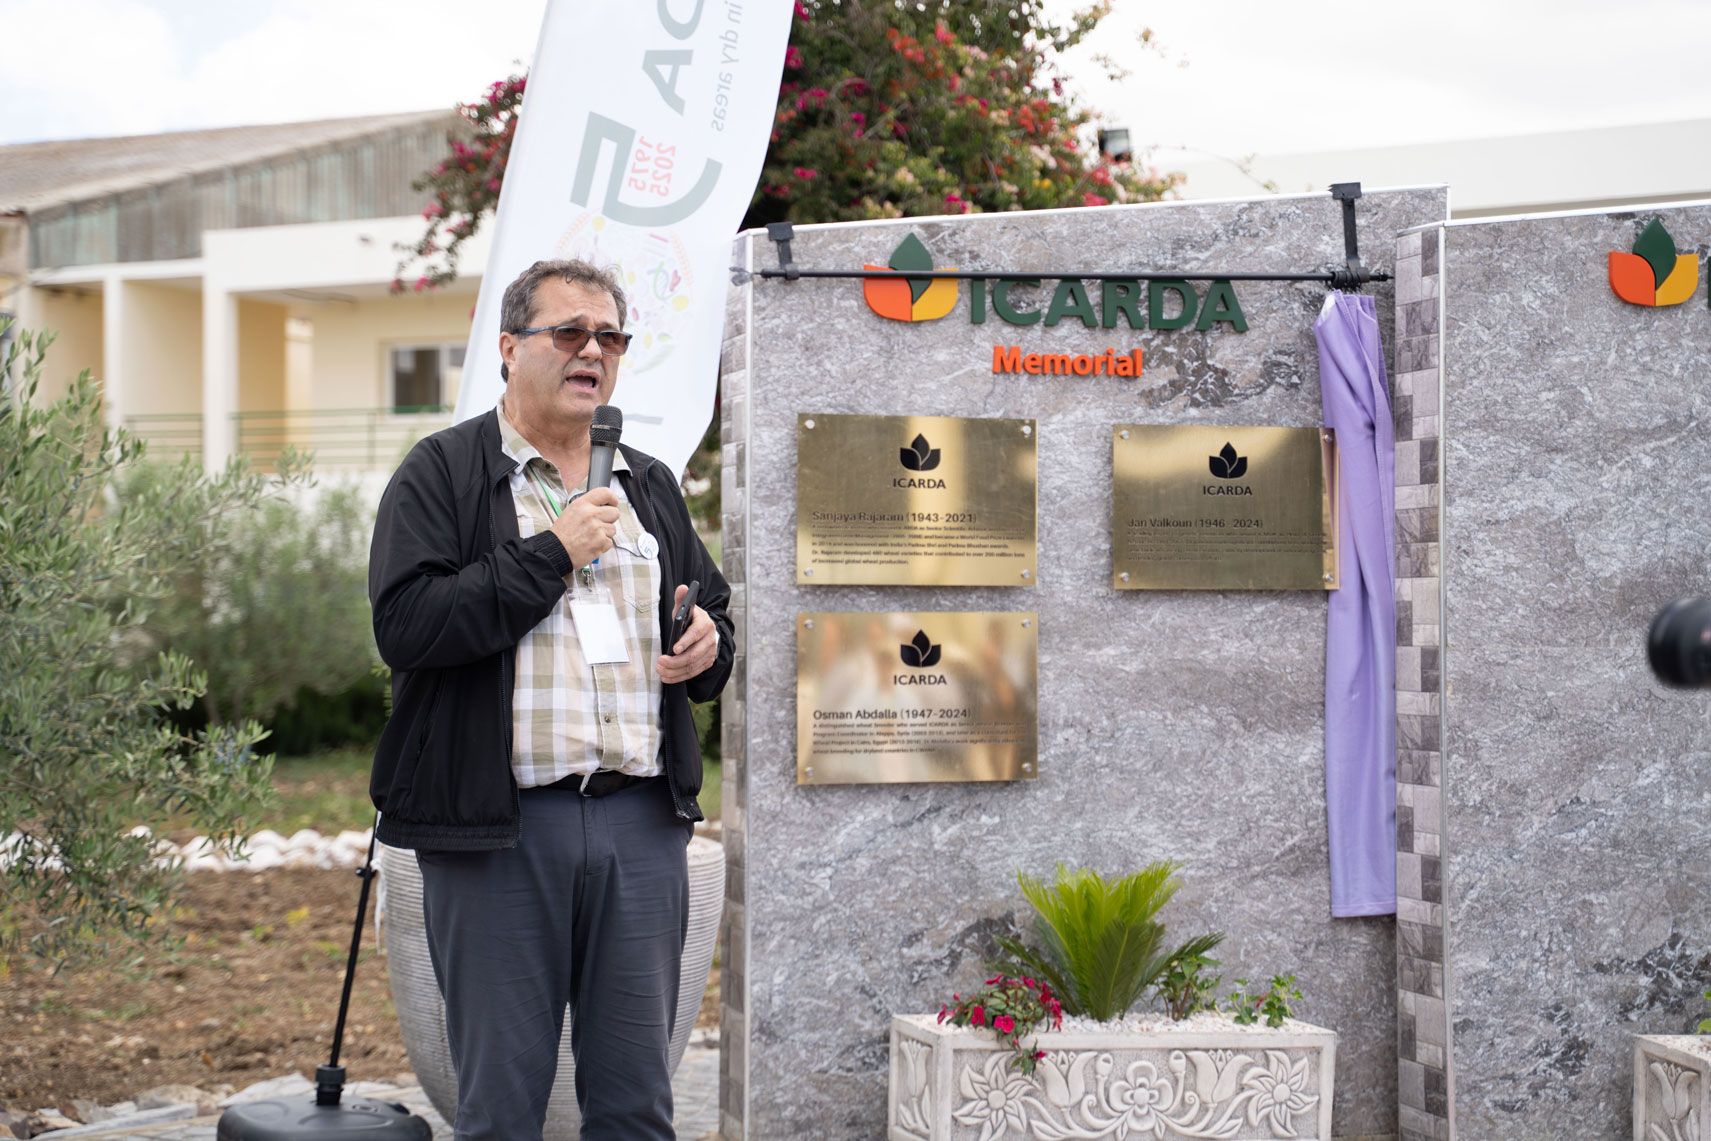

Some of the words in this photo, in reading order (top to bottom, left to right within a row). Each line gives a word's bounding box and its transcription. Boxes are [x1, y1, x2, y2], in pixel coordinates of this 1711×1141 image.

[970, 274, 1249, 332] ICARDA
[992, 345, 1143, 378] Memorial
[892, 478, 946, 489] ICARDA
[1203, 485, 1253, 496] ICARDA
[812, 511, 856, 522] Sanjaya
[859, 512, 904, 523] Rajaram
[906, 512, 977, 523] (1943-2021)
[1128, 518, 1147, 528] Jan
[1150, 518, 1192, 528] Valkoun
[893, 674, 947, 686] ICARDA
[813, 709, 853, 720] Osman
[855, 708, 897, 720] Abdalla
[900, 708, 971, 720] (1947-2024)
